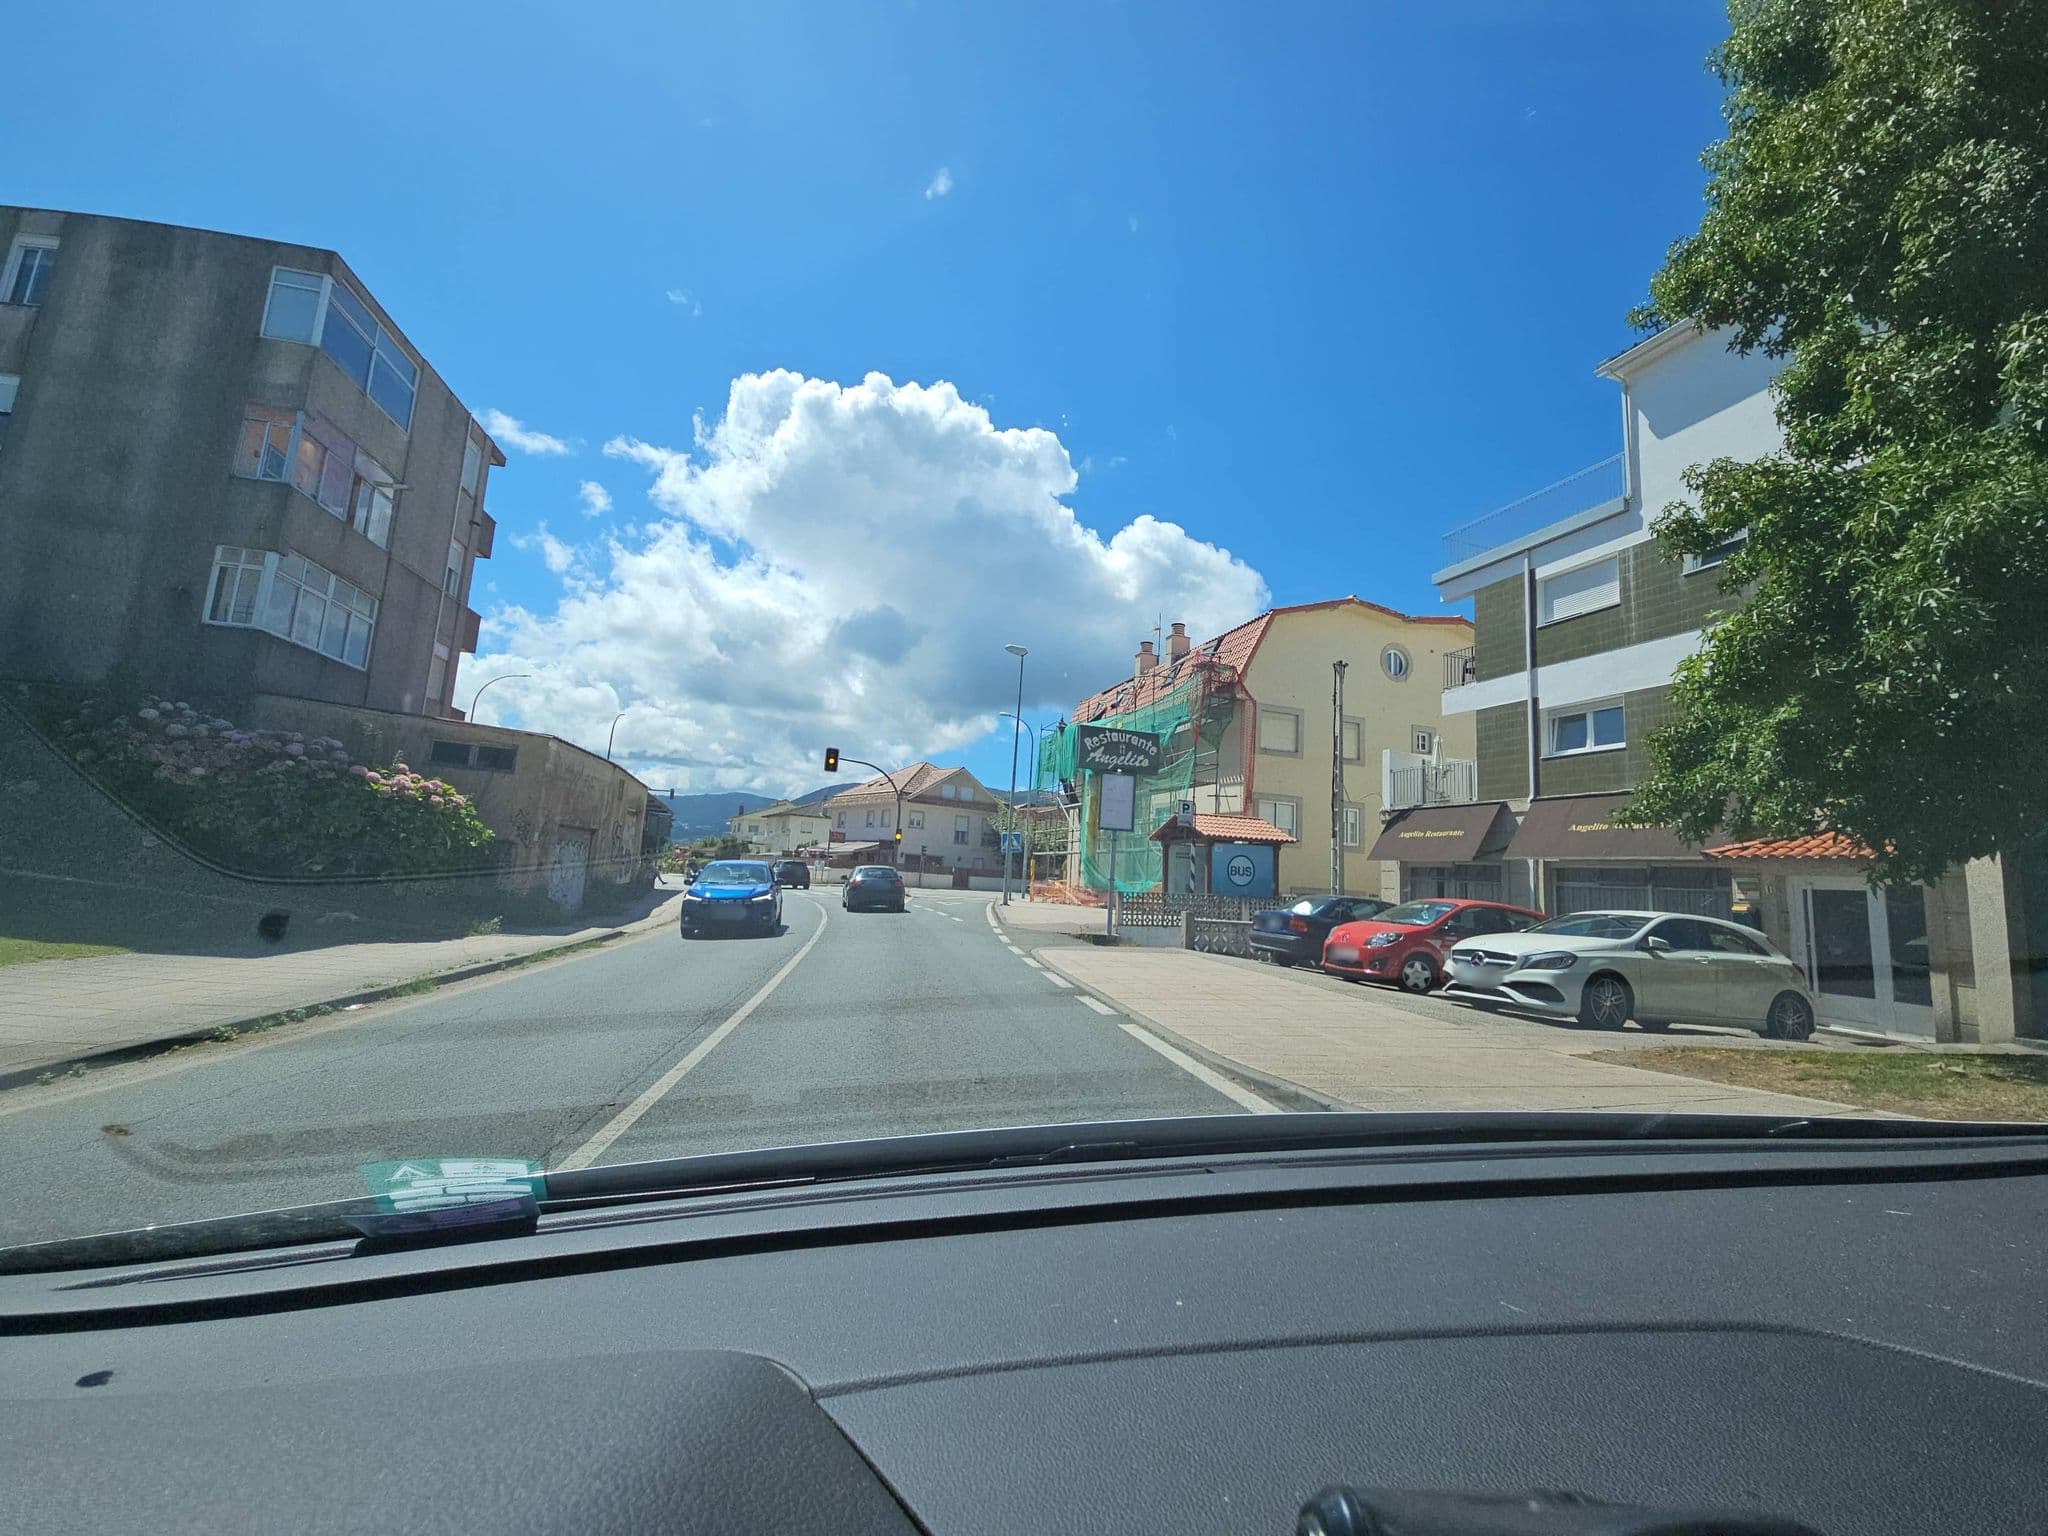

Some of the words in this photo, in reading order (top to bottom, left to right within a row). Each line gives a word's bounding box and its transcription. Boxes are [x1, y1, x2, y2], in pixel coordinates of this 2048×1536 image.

[1084, 730, 1158, 756] Restaurante
[1086, 746, 1149, 769] Angelito
[1182, 803, 1191, 814] P
[1568, 822, 1609, 832] Angelito
[1398, 831, 1425, 839] Angelito
[1425, 830, 1465, 838] Restaurante
[1230, 865, 1252, 877] BUS
